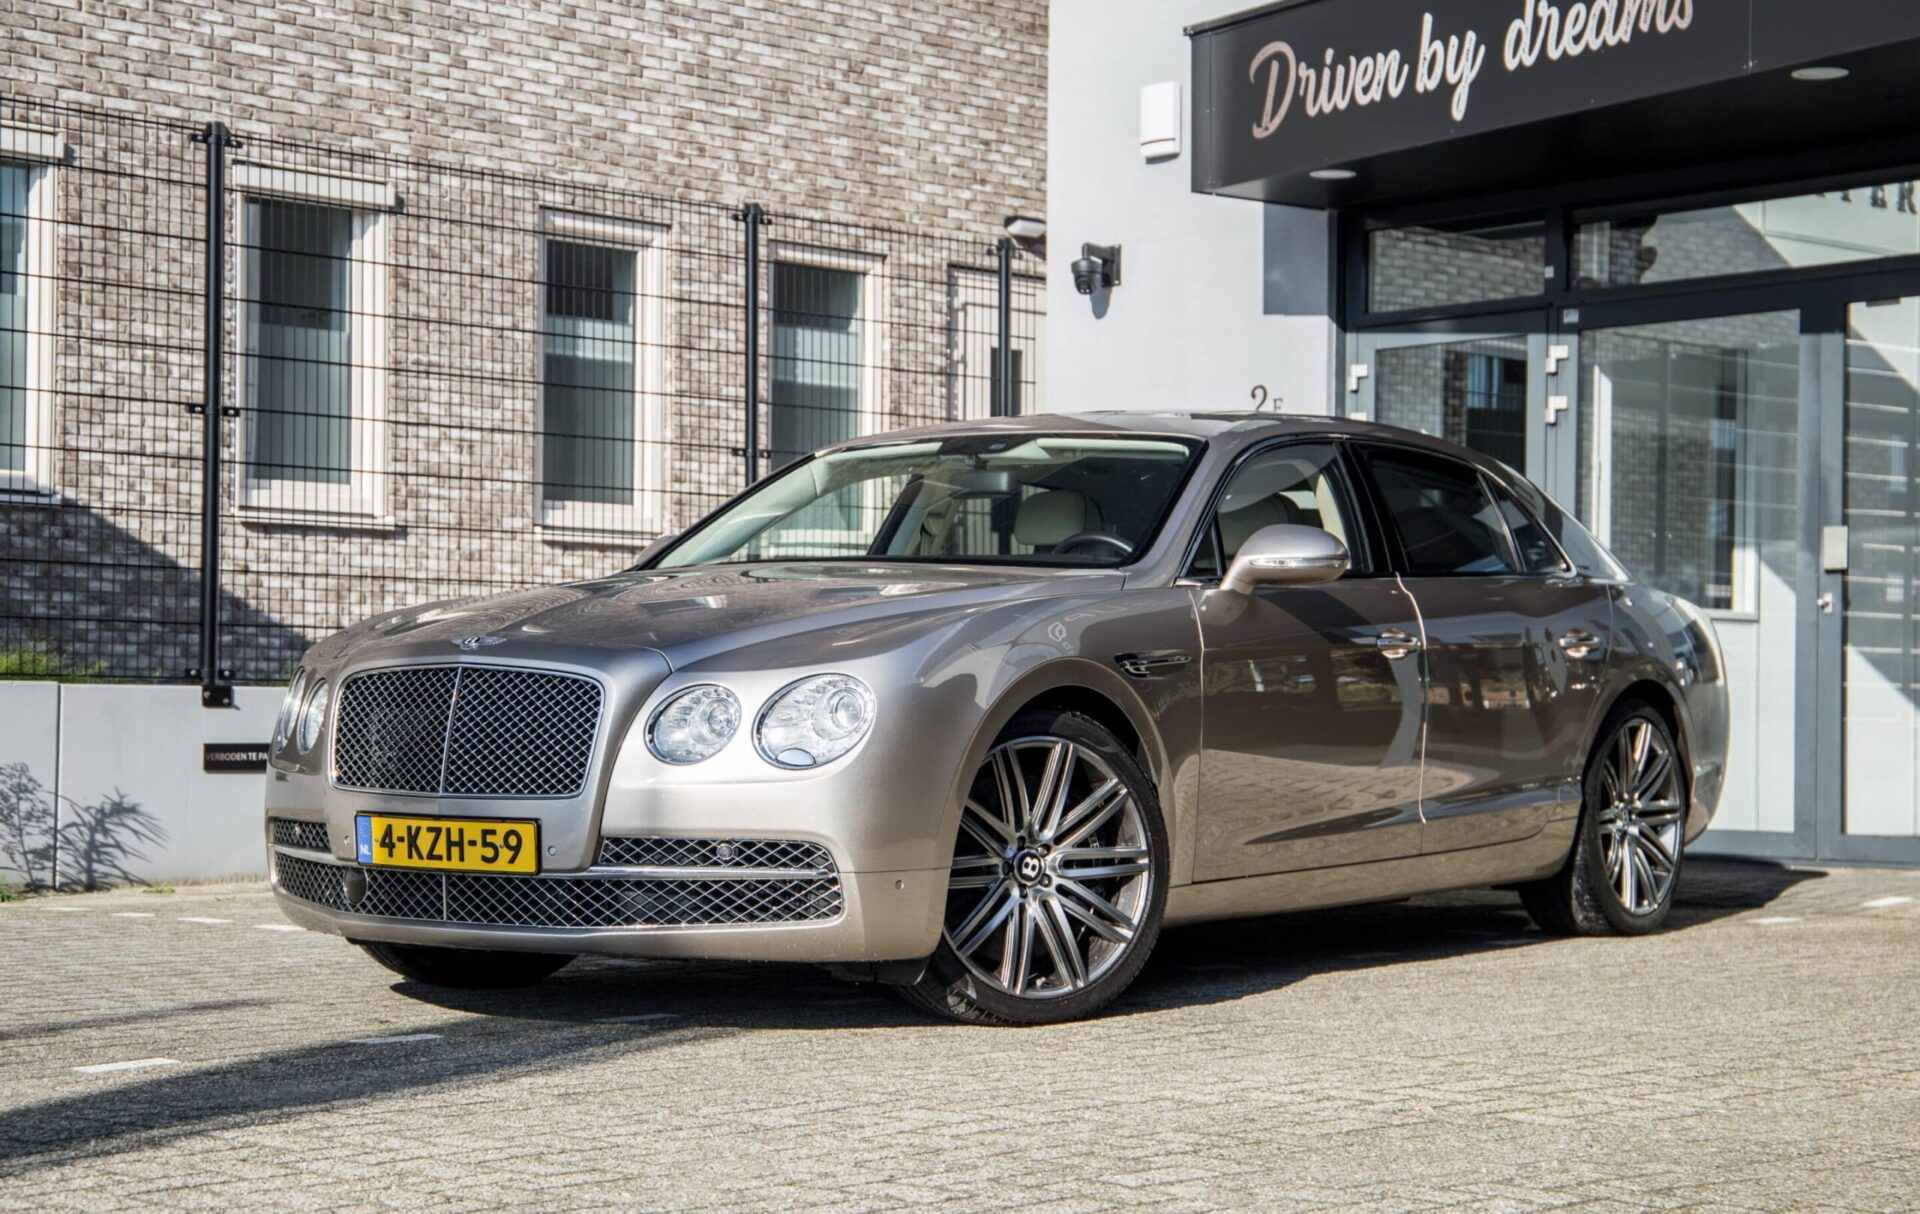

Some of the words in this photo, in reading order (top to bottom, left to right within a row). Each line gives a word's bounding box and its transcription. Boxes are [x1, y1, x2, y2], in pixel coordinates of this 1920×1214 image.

[1250, 41, 1409, 139] Driven
[1415, 12, 1485, 122] by
[1504, 0, 1693, 71] dreams
[206, 752, 247, 761] VERBODEN
[247, 752, 257, 761] TE
[258, 752, 268, 761] PA
[360, 844, 371, 855] NL
[379, 823, 522, 864] 4-KZH-59
